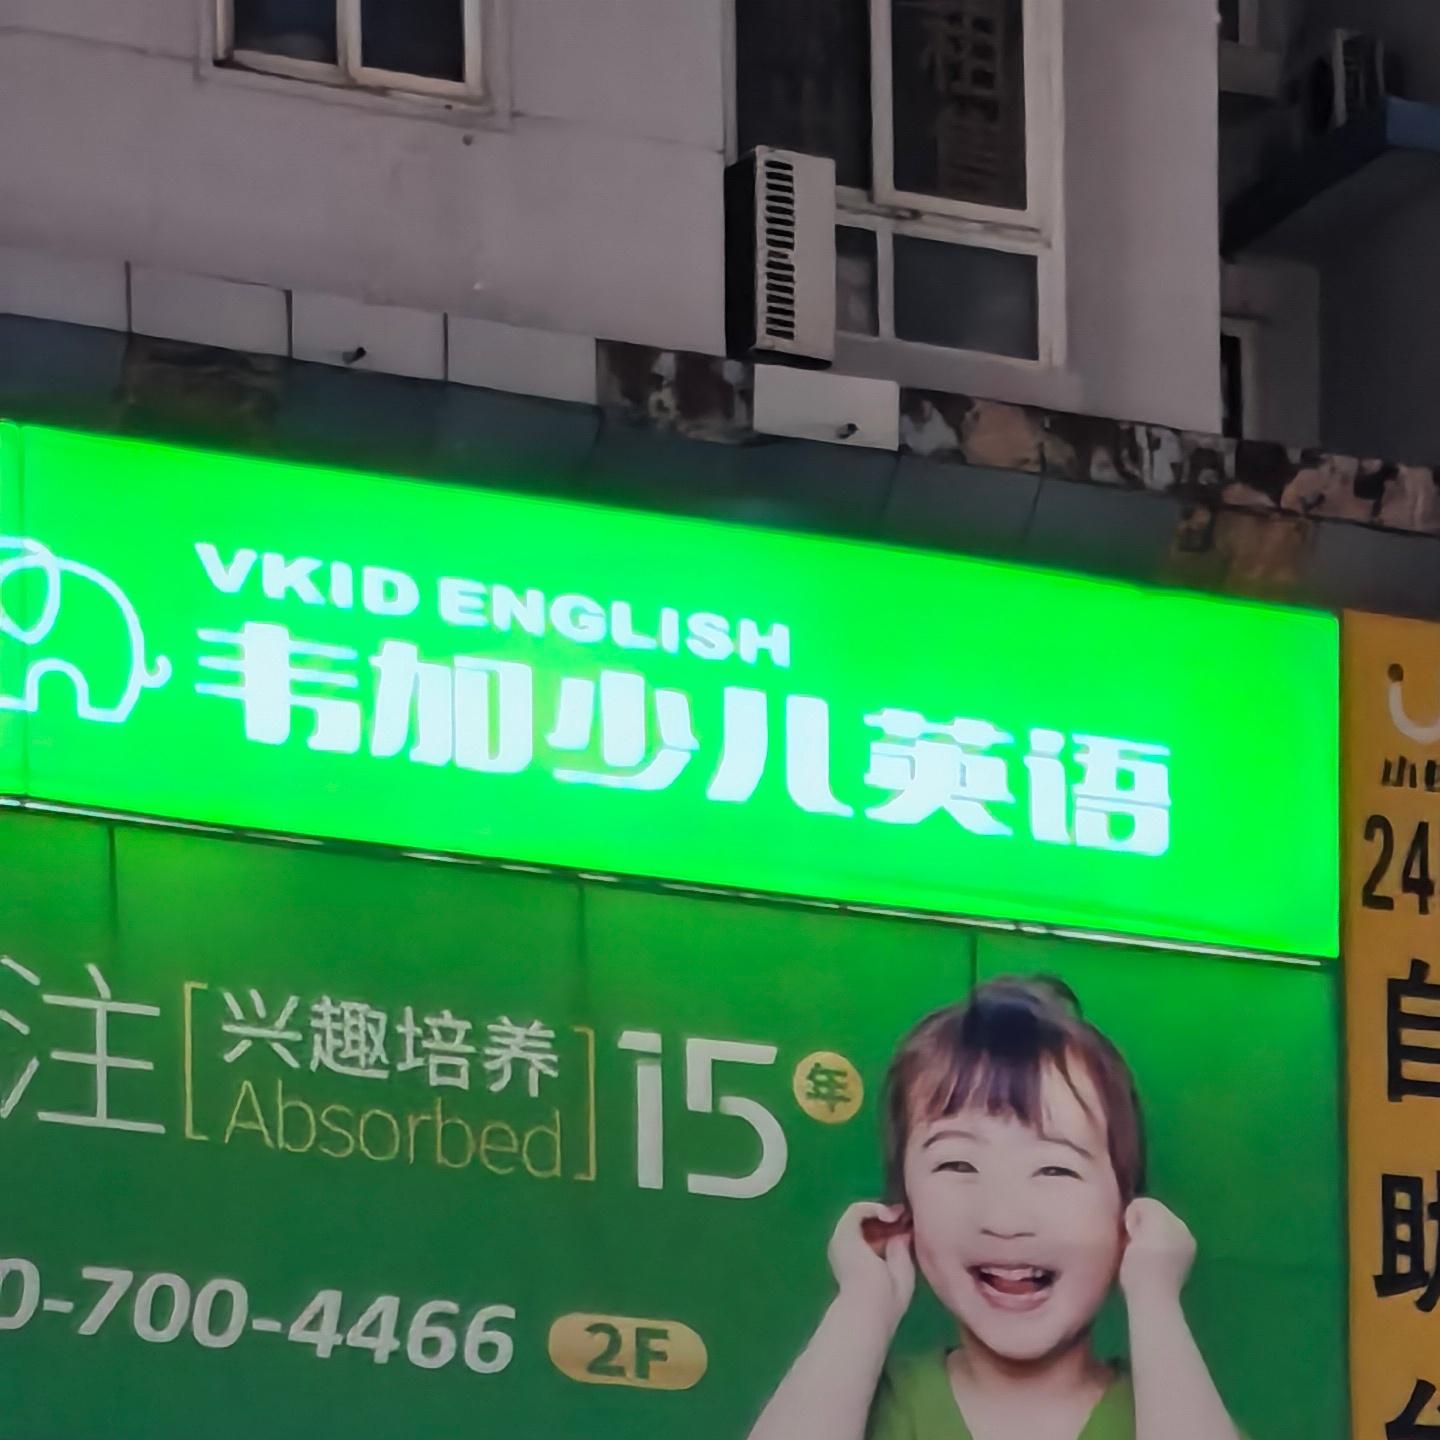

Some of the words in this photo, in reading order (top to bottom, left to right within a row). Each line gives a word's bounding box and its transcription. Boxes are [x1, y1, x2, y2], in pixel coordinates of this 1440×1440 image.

[194, 541, 421, 616] VKID
[437, 577, 791, 669] ENGLISH
[194, 620, 1171, 857] 韦加少儿英语
[0, 953, 166, 1135] 注
[220, 986, 561, 1099] 兴趣培养
[223, 1078, 563, 1179] Absorbed
[585, 1322, 670, 1381] 2F
